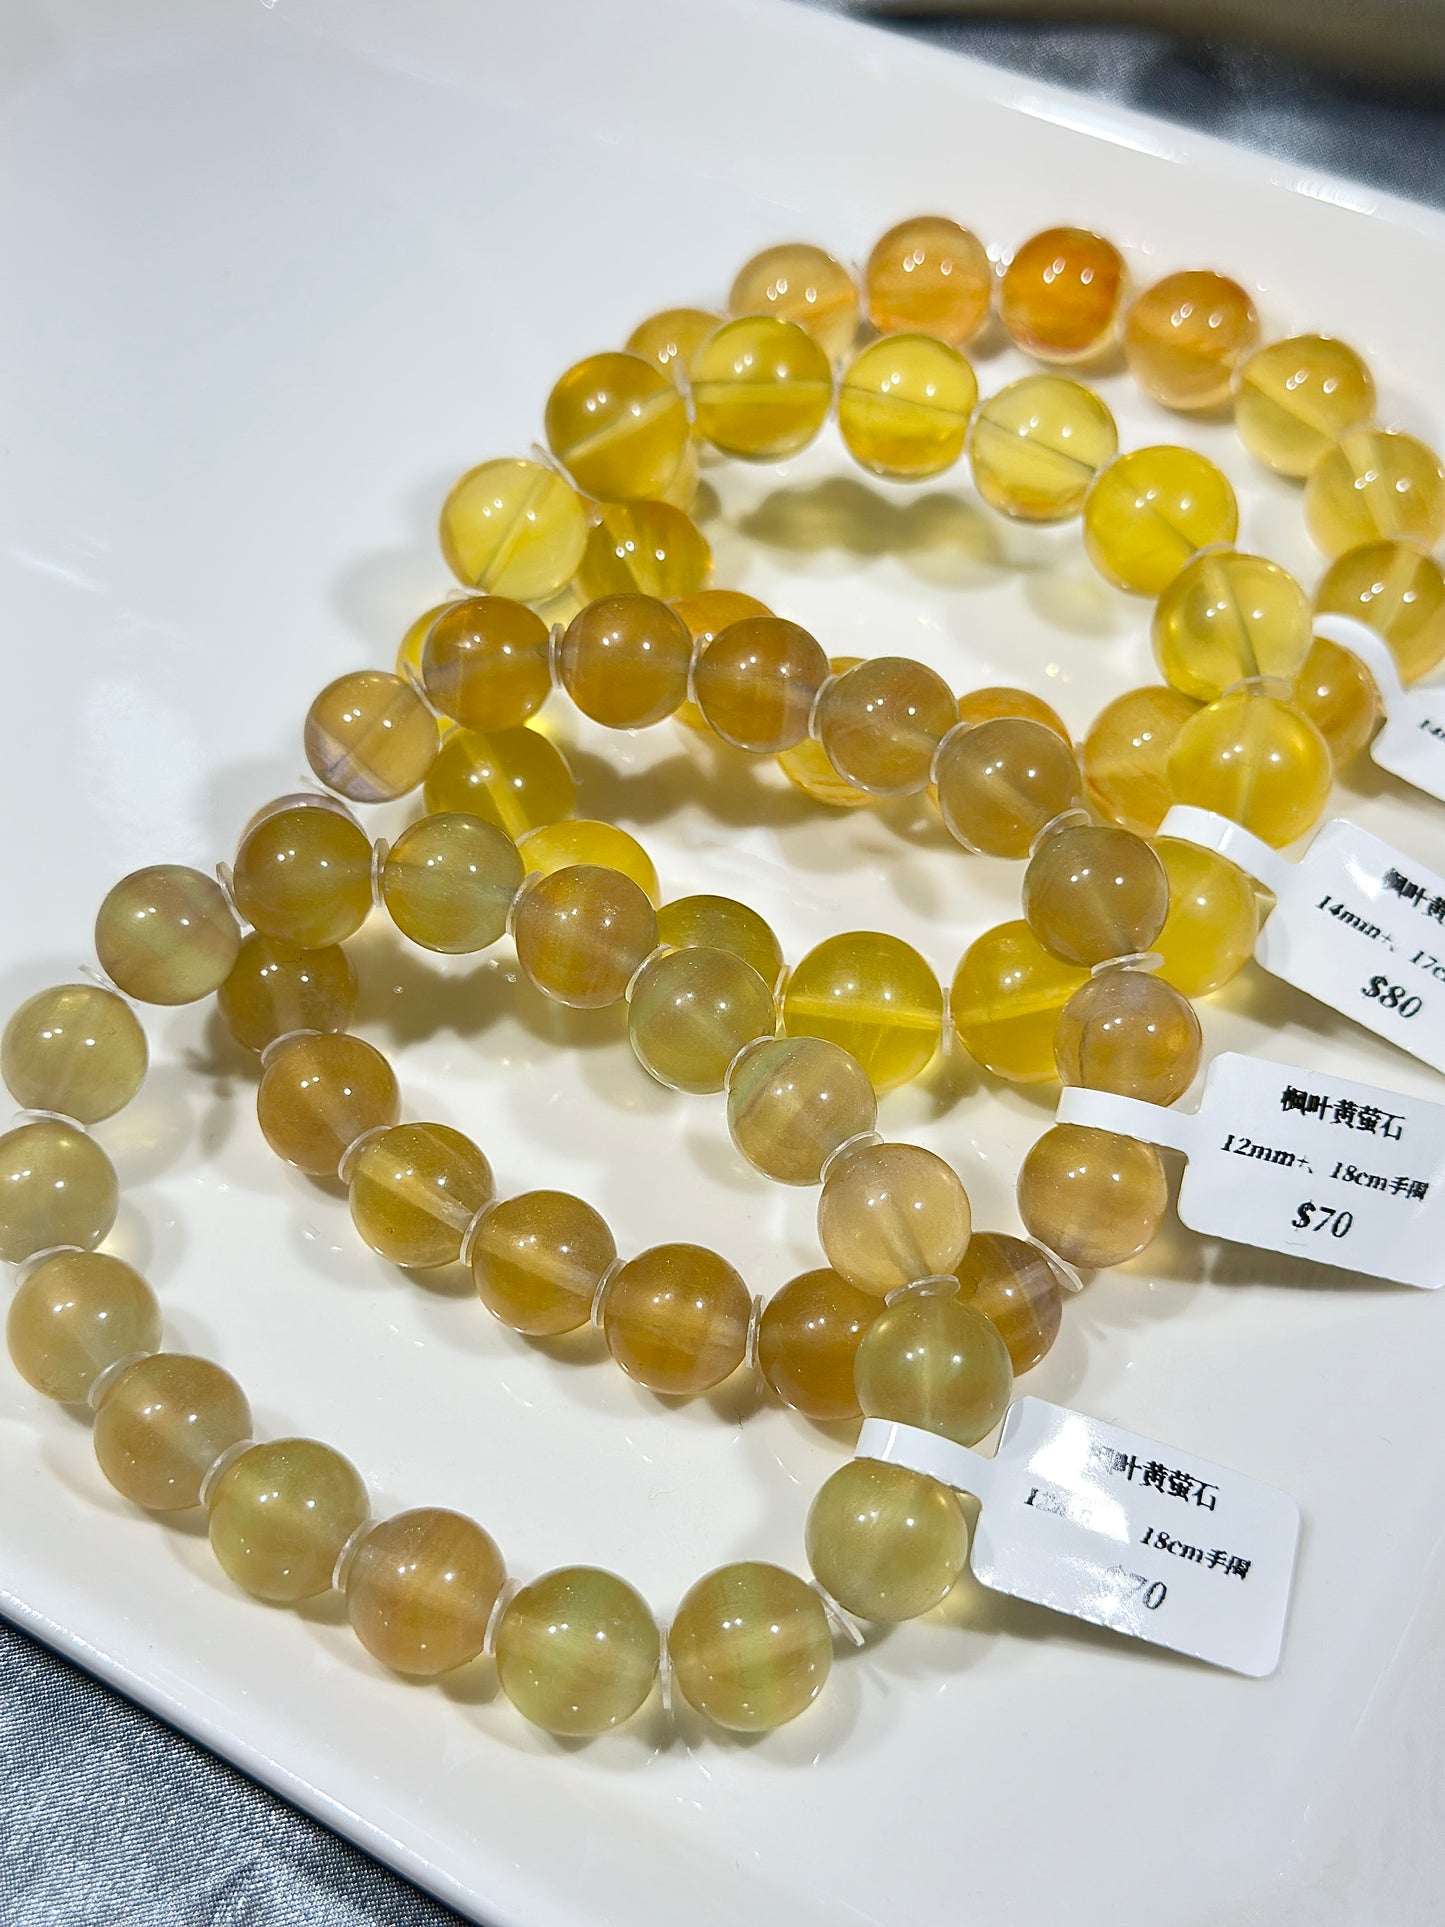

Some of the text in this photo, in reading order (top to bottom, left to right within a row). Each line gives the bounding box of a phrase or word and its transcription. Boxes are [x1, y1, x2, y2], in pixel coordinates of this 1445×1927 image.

[1360, 974, 1423, 1018] $80
[1280, 1085, 1407, 1141] 枫叶黄萤石
[1291, 1199, 1353, 1238] $70
